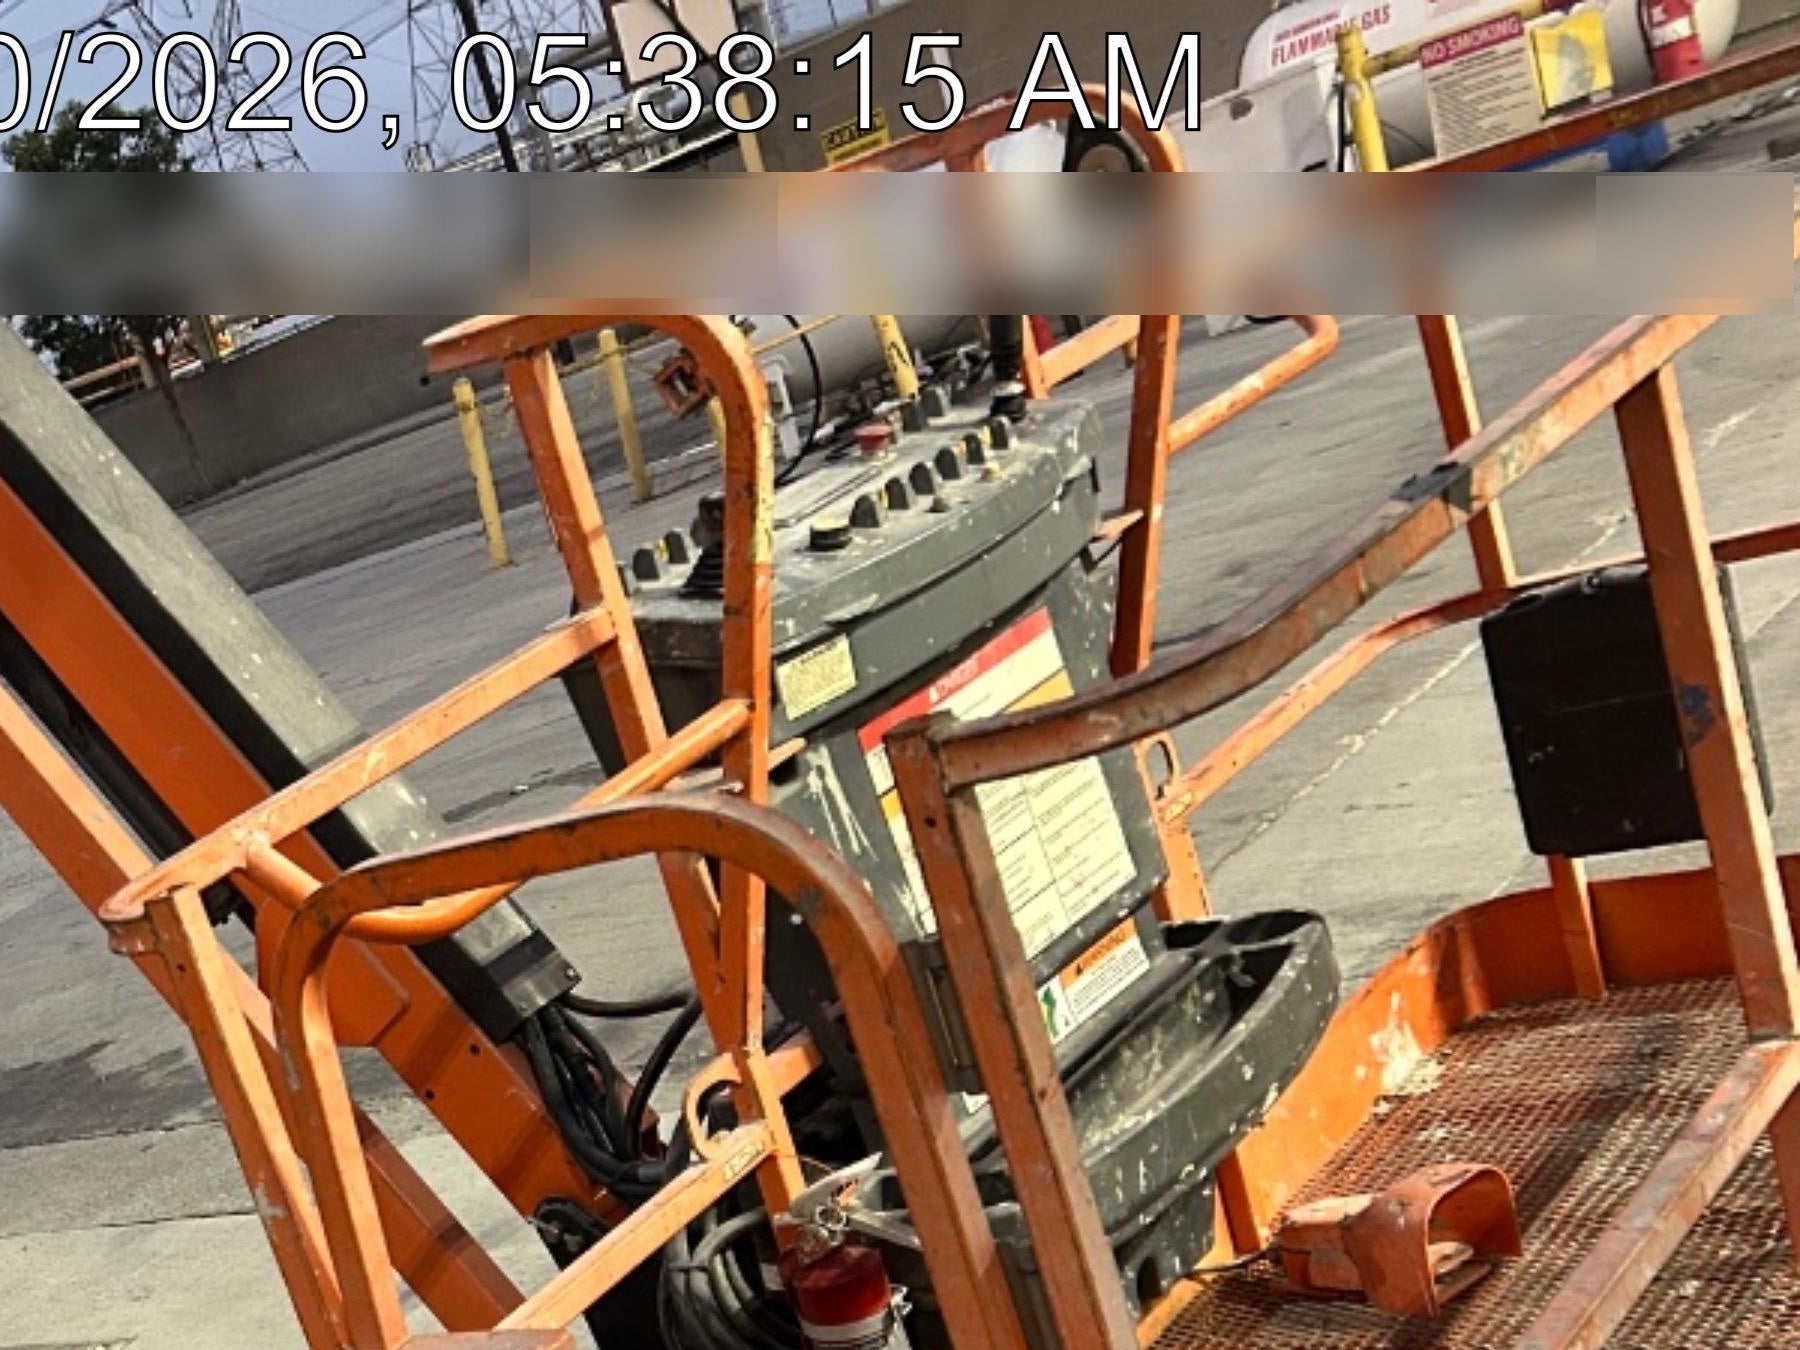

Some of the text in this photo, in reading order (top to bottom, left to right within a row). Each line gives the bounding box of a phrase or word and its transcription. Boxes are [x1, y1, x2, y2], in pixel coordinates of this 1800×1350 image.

[1271, 17, 1356, 66] FLAMMA
[1361, 3, 1391, 31] GAS
[1422, 14, 1520, 63] NO SMOKING
